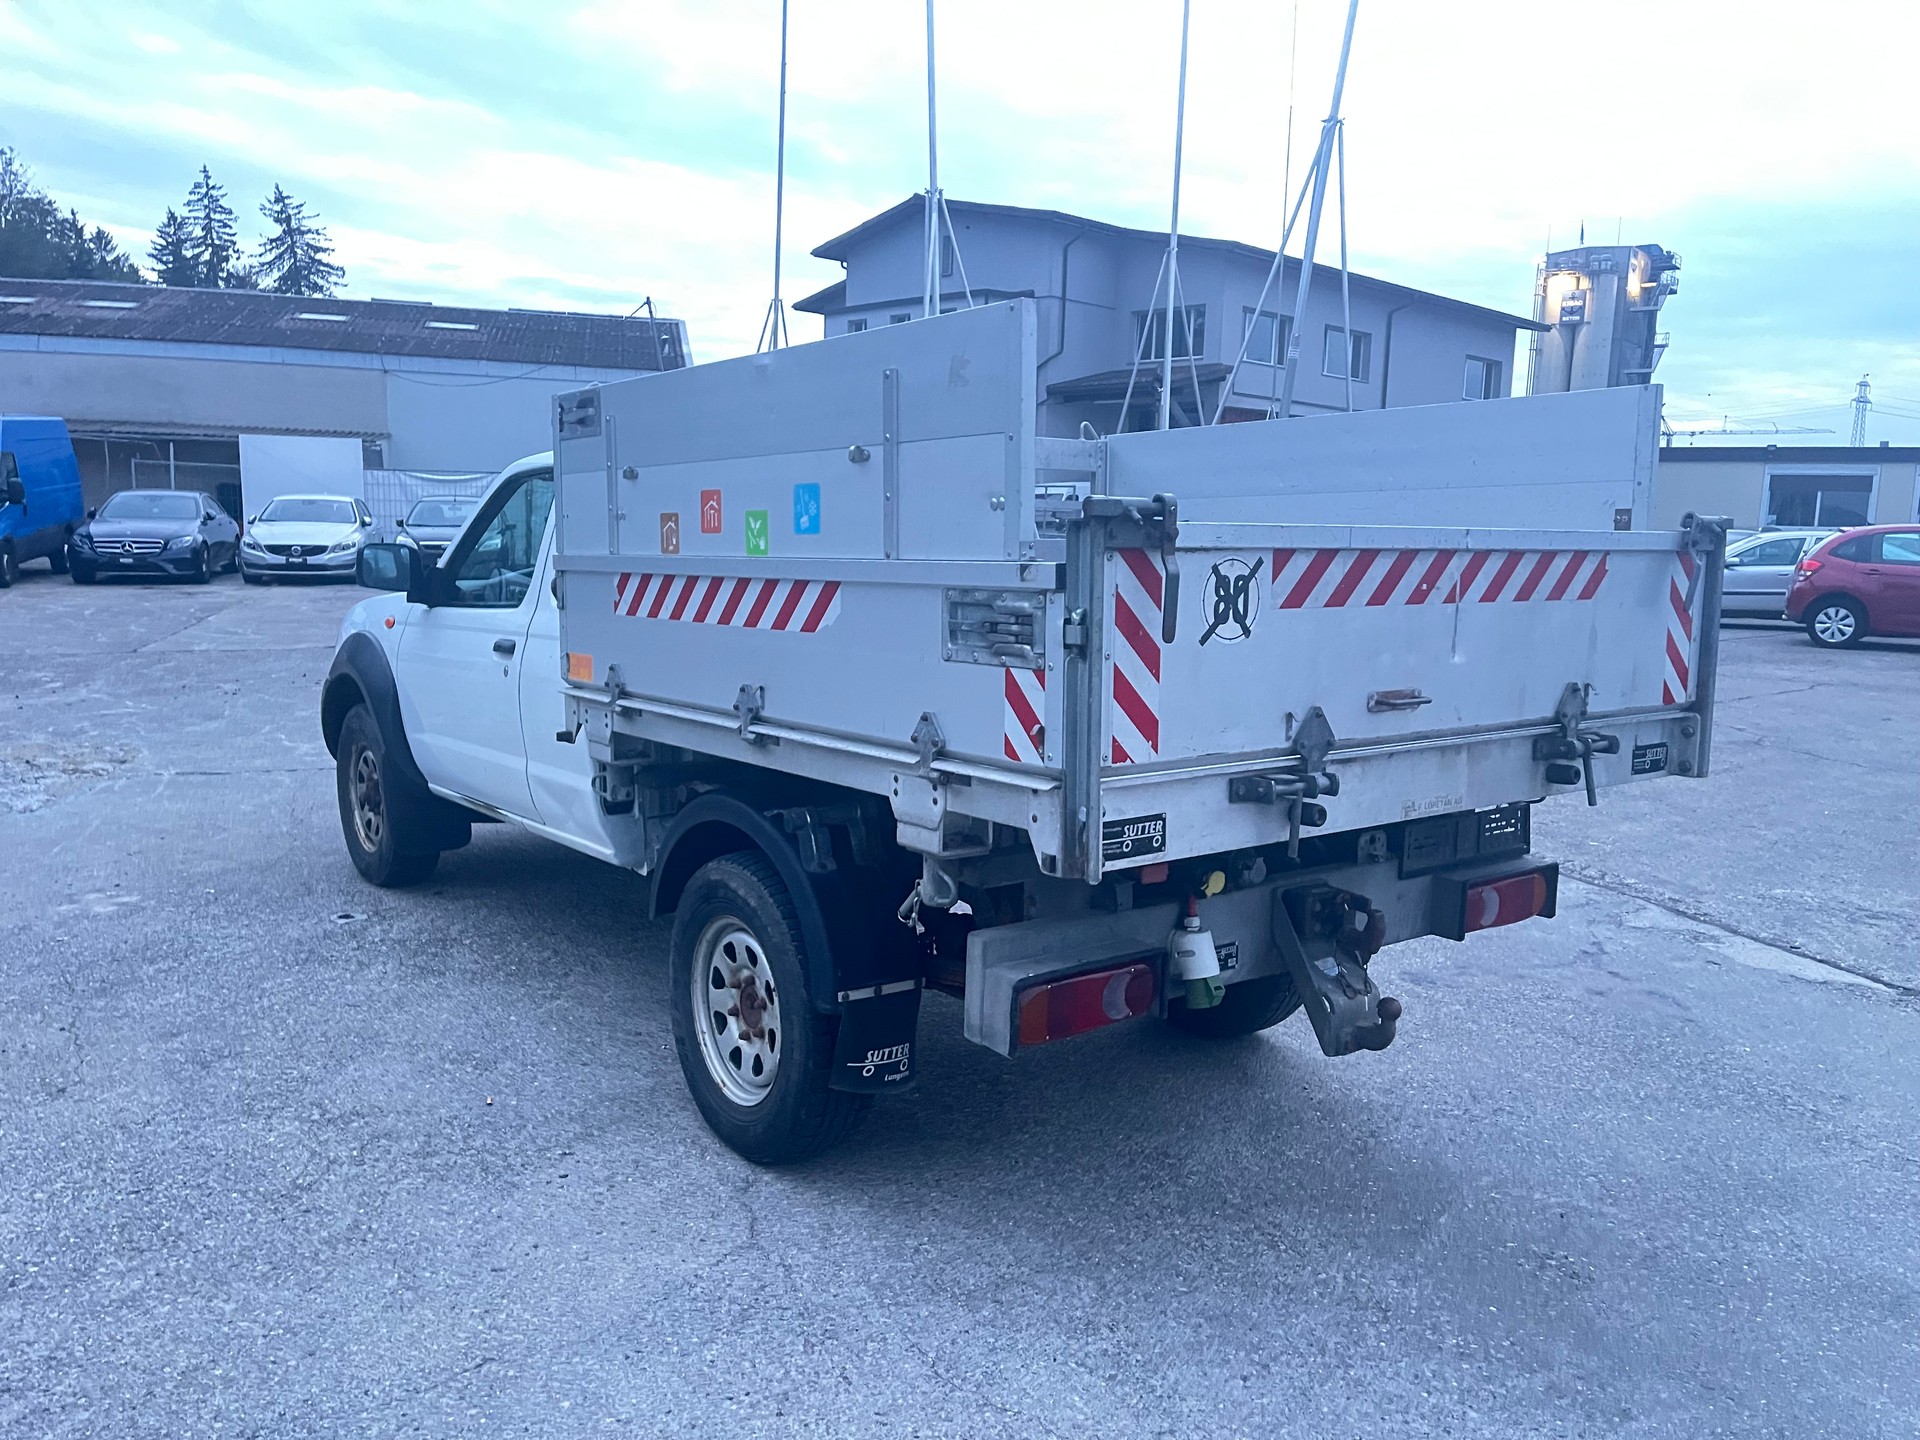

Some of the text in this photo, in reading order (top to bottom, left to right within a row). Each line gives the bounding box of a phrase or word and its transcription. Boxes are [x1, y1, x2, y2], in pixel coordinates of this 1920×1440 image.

[1646, 747, 1667, 758] SUTTER
[1123, 820, 1163, 838] SUTTER
[865, 1043, 910, 1063] SUTTER
